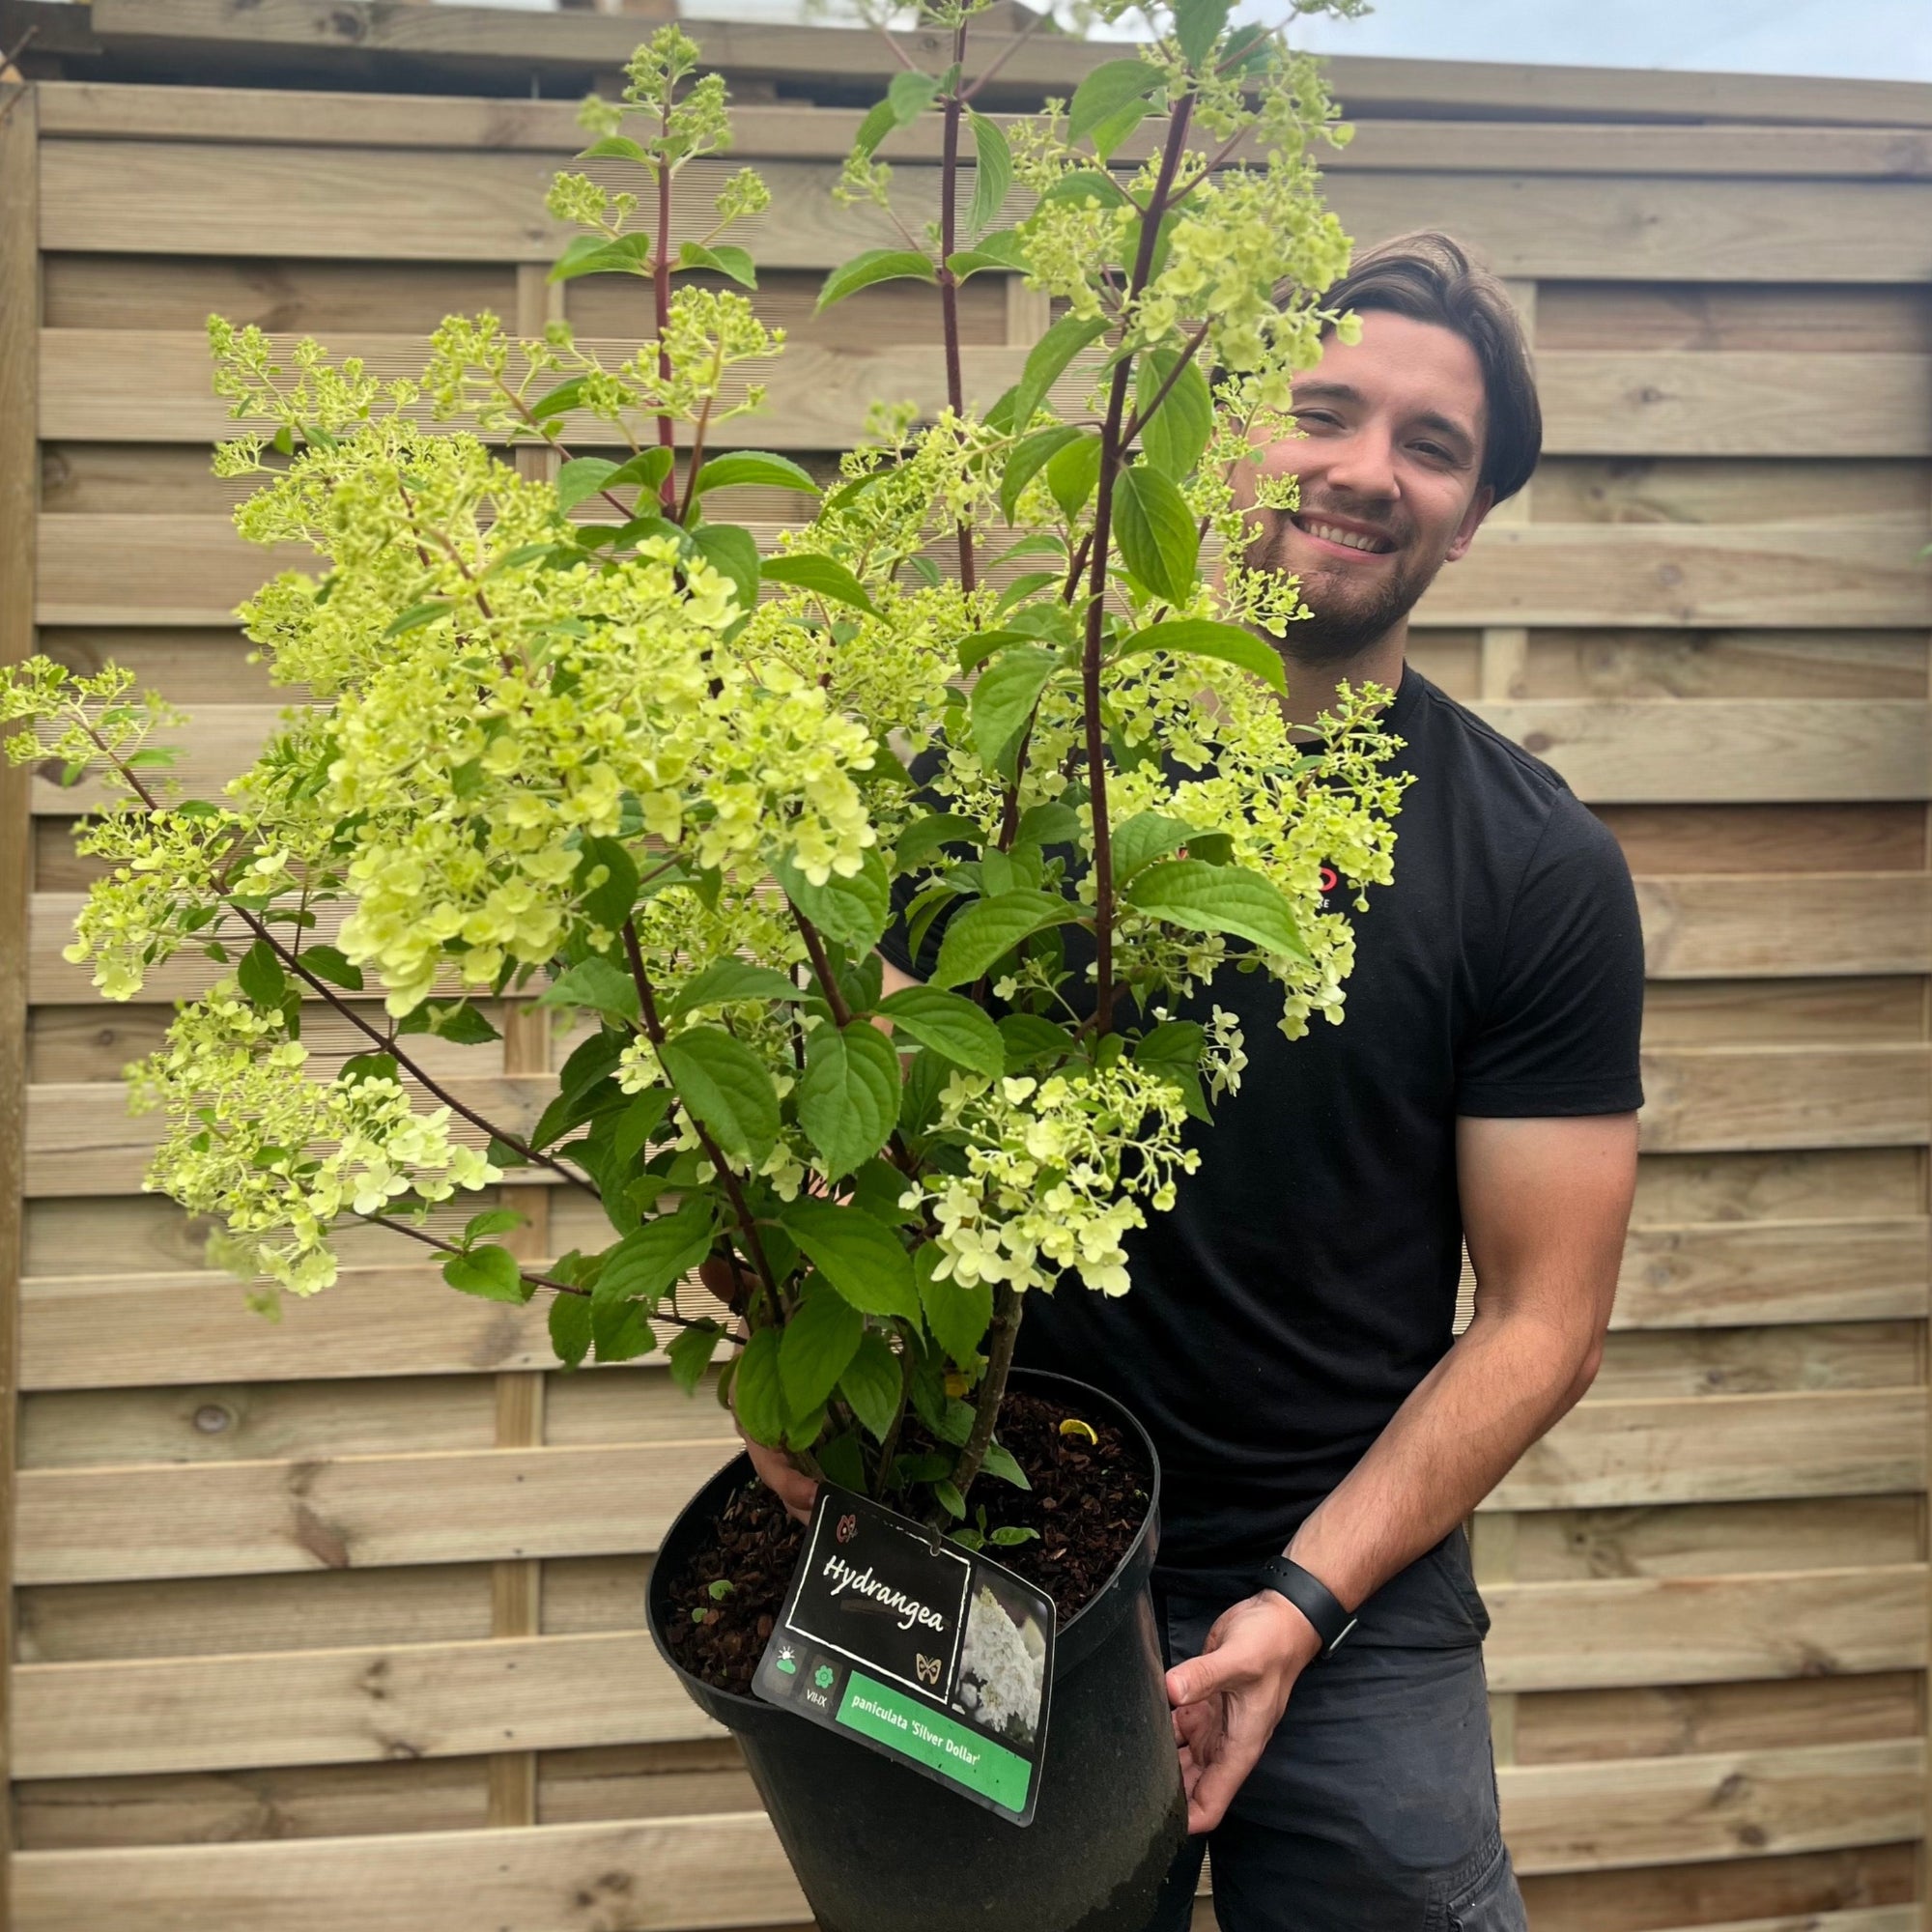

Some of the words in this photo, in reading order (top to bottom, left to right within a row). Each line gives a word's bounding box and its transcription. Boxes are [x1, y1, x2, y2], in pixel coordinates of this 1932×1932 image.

[823, 1555, 944, 1632] Hydrangea
[851, 1695, 909, 1730] paniculata
[911, 1719, 944, 1747] 'Silver
[945, 1739, 980, 1765] Dollar'
